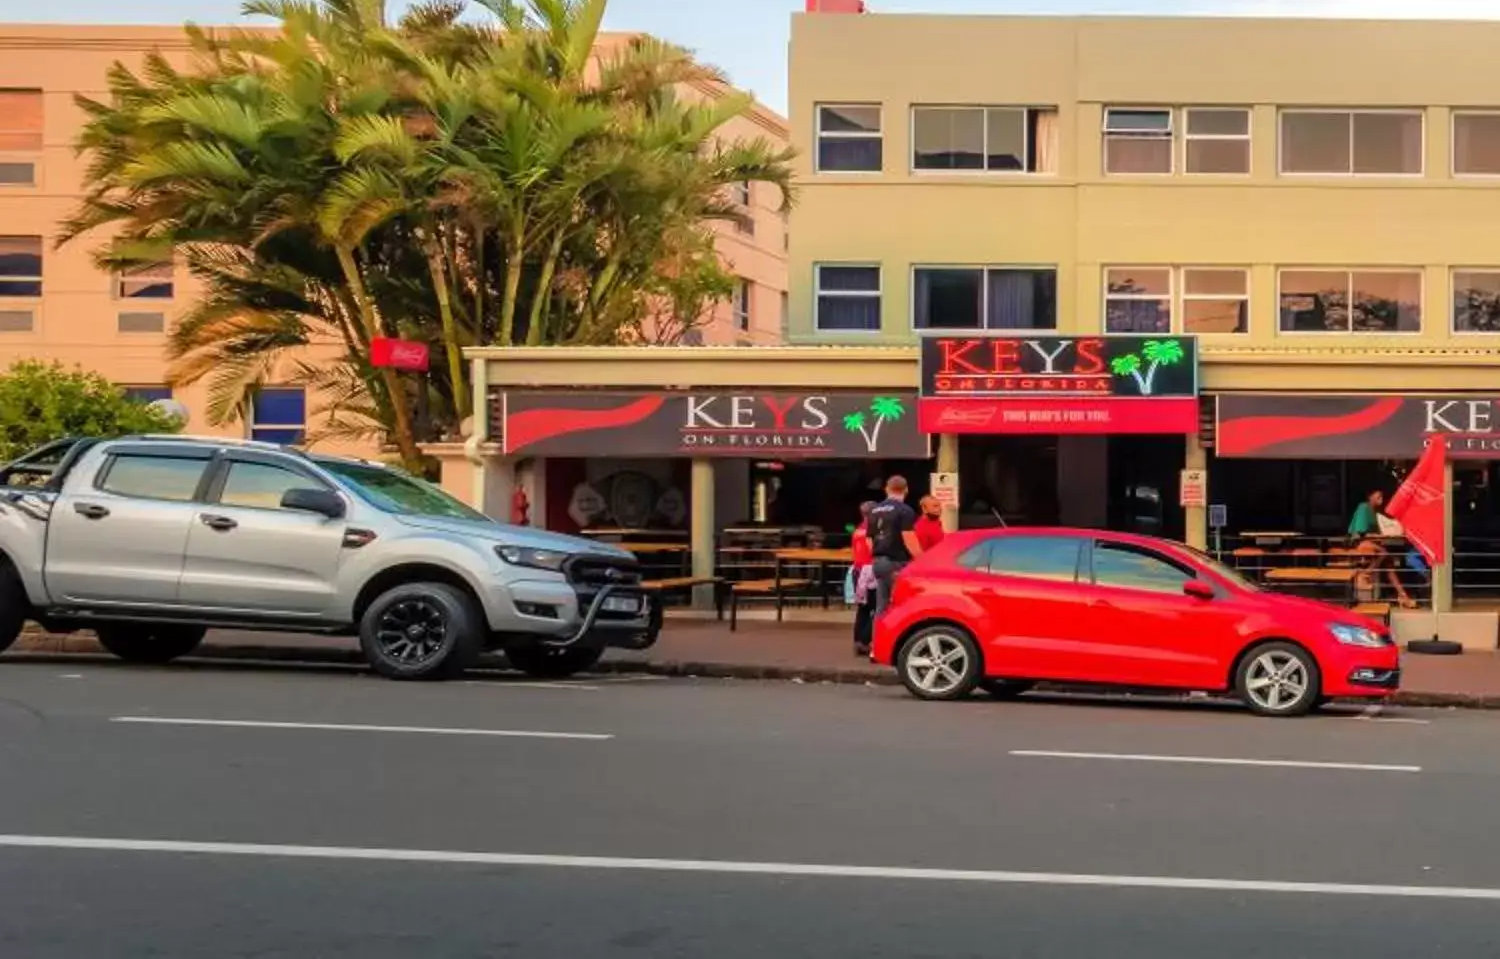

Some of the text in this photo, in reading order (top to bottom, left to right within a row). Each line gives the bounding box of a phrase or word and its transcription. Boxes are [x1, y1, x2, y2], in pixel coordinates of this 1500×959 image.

[936, 340, 1105, 375] KEYS
[986, 378, 1108, 389] FLORIDA
[685, 396, 829, 432] KEYS
[683, 435, 824, 446] ON FLORIDA
